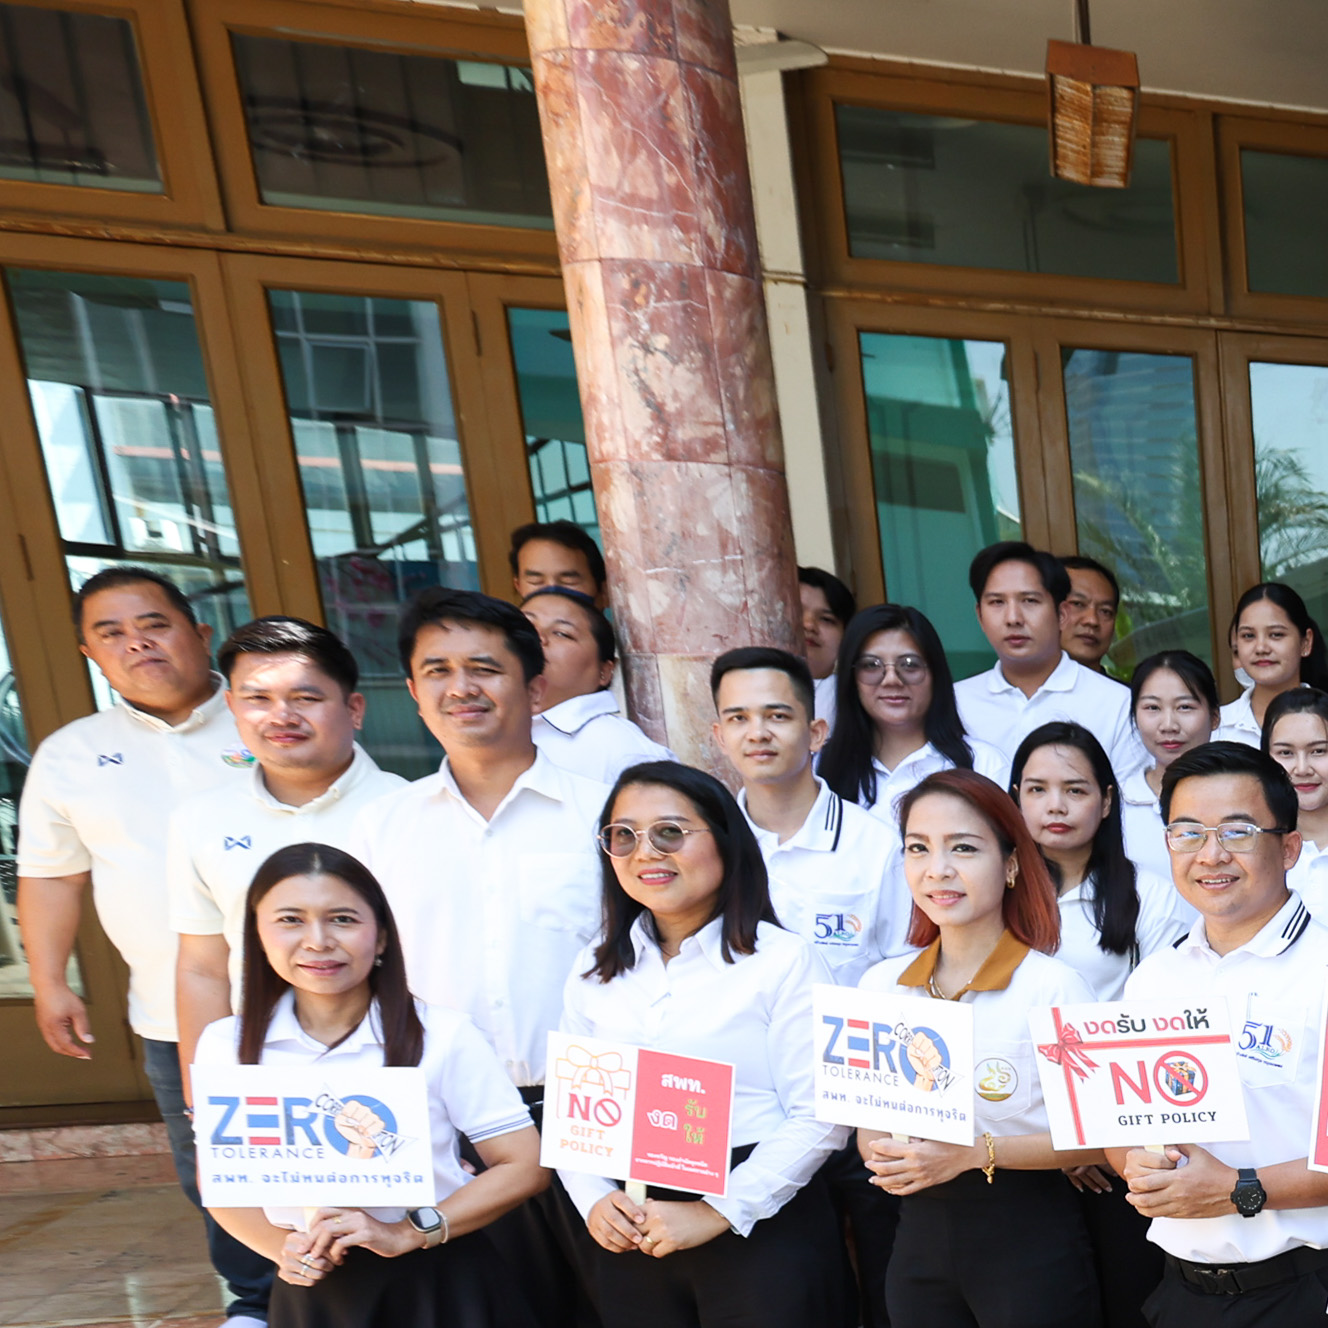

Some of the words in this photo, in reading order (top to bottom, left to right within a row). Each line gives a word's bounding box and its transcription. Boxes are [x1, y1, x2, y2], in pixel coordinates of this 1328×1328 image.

[814, 913, 845, 938] 51
[1083, 1013, 1147, 1035] งดรับ
[1152, 1008, 1210, 1031] งดให้
[1238, 1020, 1273, 1050] 51
[822, 1014, 951, 1092] ZERO
[661, 1073, 706, 1094] สพท.
[822, 1064, 899, 1087] TOLERANCE
[1109, 1050, 1209, 1107] NO
[567, 1093, 622, 1127] NO
[684, 1099, 706, 1118] รับ
[855, 1095, 967, 1122] จะไม่ทนต่อการทุจริต
[1118, 1114, 1154, 1126] GIFT
[1161, 1111, 1217, 1125] POLICY
[208, 1095, 397, 1159] ZERO
[647, 1109, 678, 1131] งด
[570, 1125, 605, 1140] GIFT
[683, 1123, 705, 1144] ให้
[210, 1147, 325, 1159] TOLERANCE
[560, 1138, 614, 1157] POLICY
[262, 1171, 424, 1188] จะไม่ทนต่อการทุจริต
